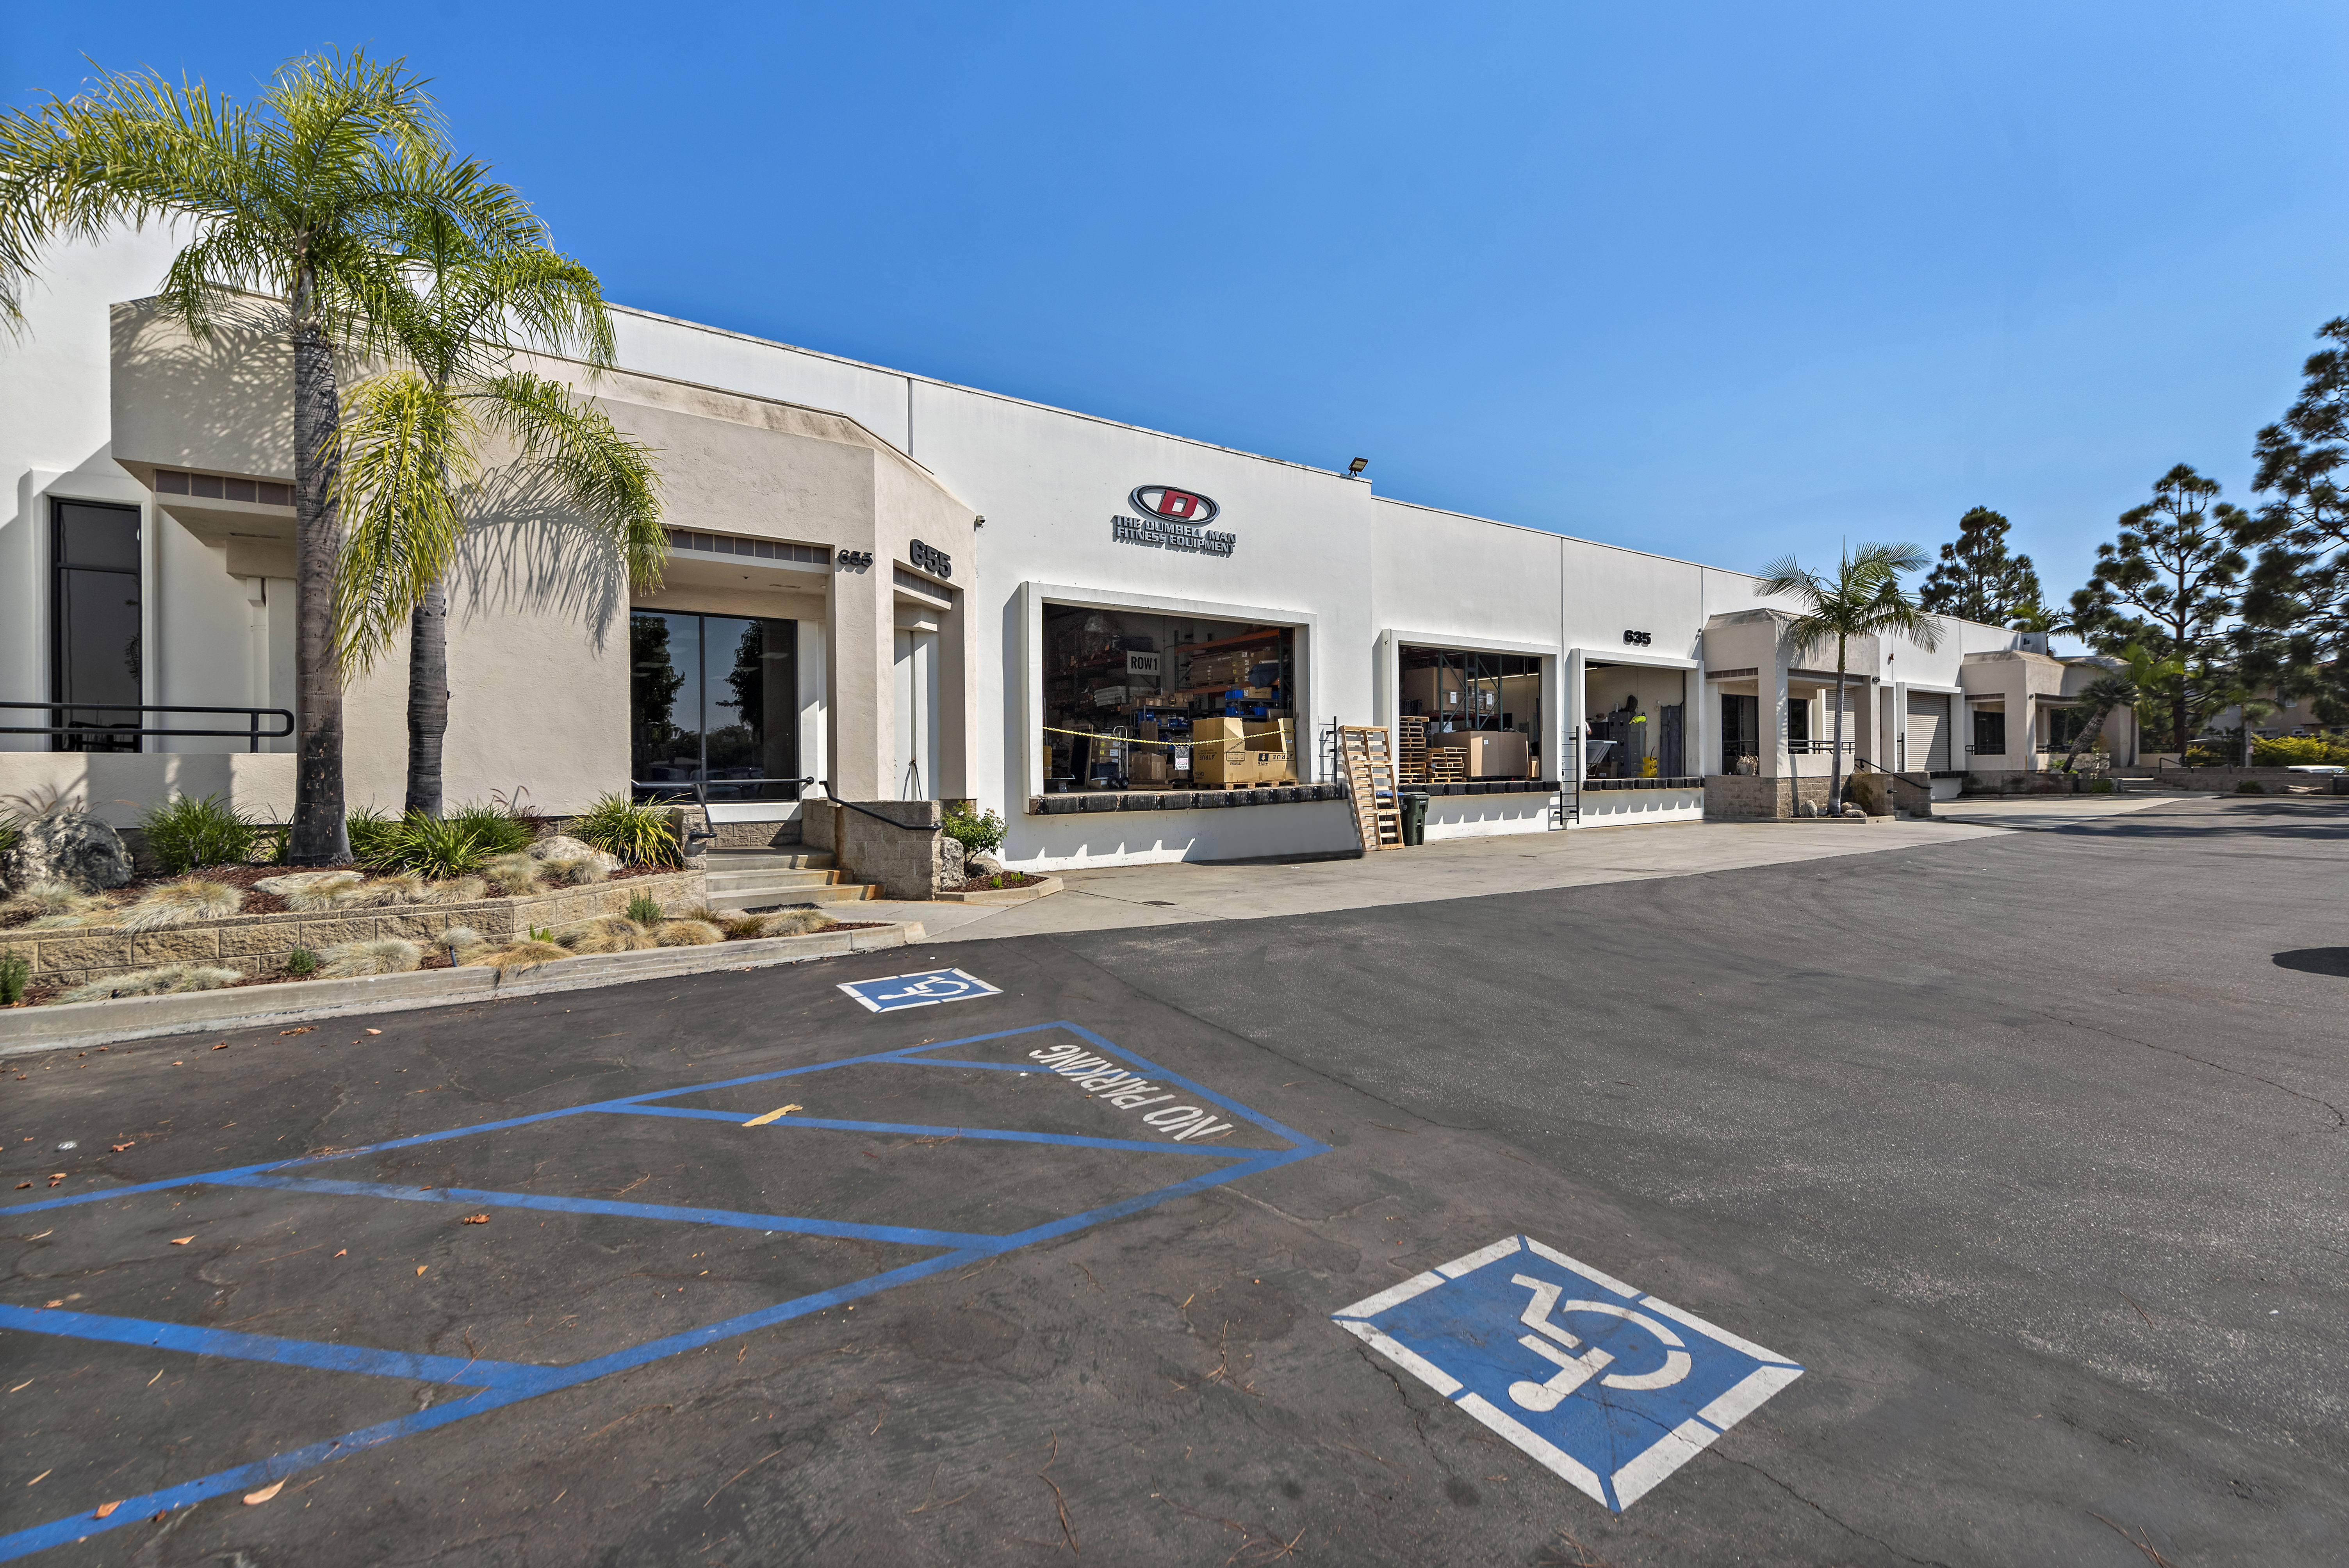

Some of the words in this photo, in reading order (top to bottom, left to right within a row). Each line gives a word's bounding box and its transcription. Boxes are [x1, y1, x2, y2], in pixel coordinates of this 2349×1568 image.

[1158, 490, 1198, 518] D
[1116, 515, 1141, 528] THE
[1145, 520, 1205, 538] DUMBELL
[1208, 530, 1236, 543] MAN
[1116, 527, 1167, 543] FITNESS
[1169, 535, 1235, 553] EQUIPMENT
[838, 549, 873, 566] 655
[910, 539, 952, 577] 655
[1624, 630, 1651, 645] 635
[1131, 656, 1152, 670] ROW
[1154, 658, 1157, 670] 1
[1029, 1045, 1176, 1110] PARKING
[1143, 1106, 1234, 1141] NO
